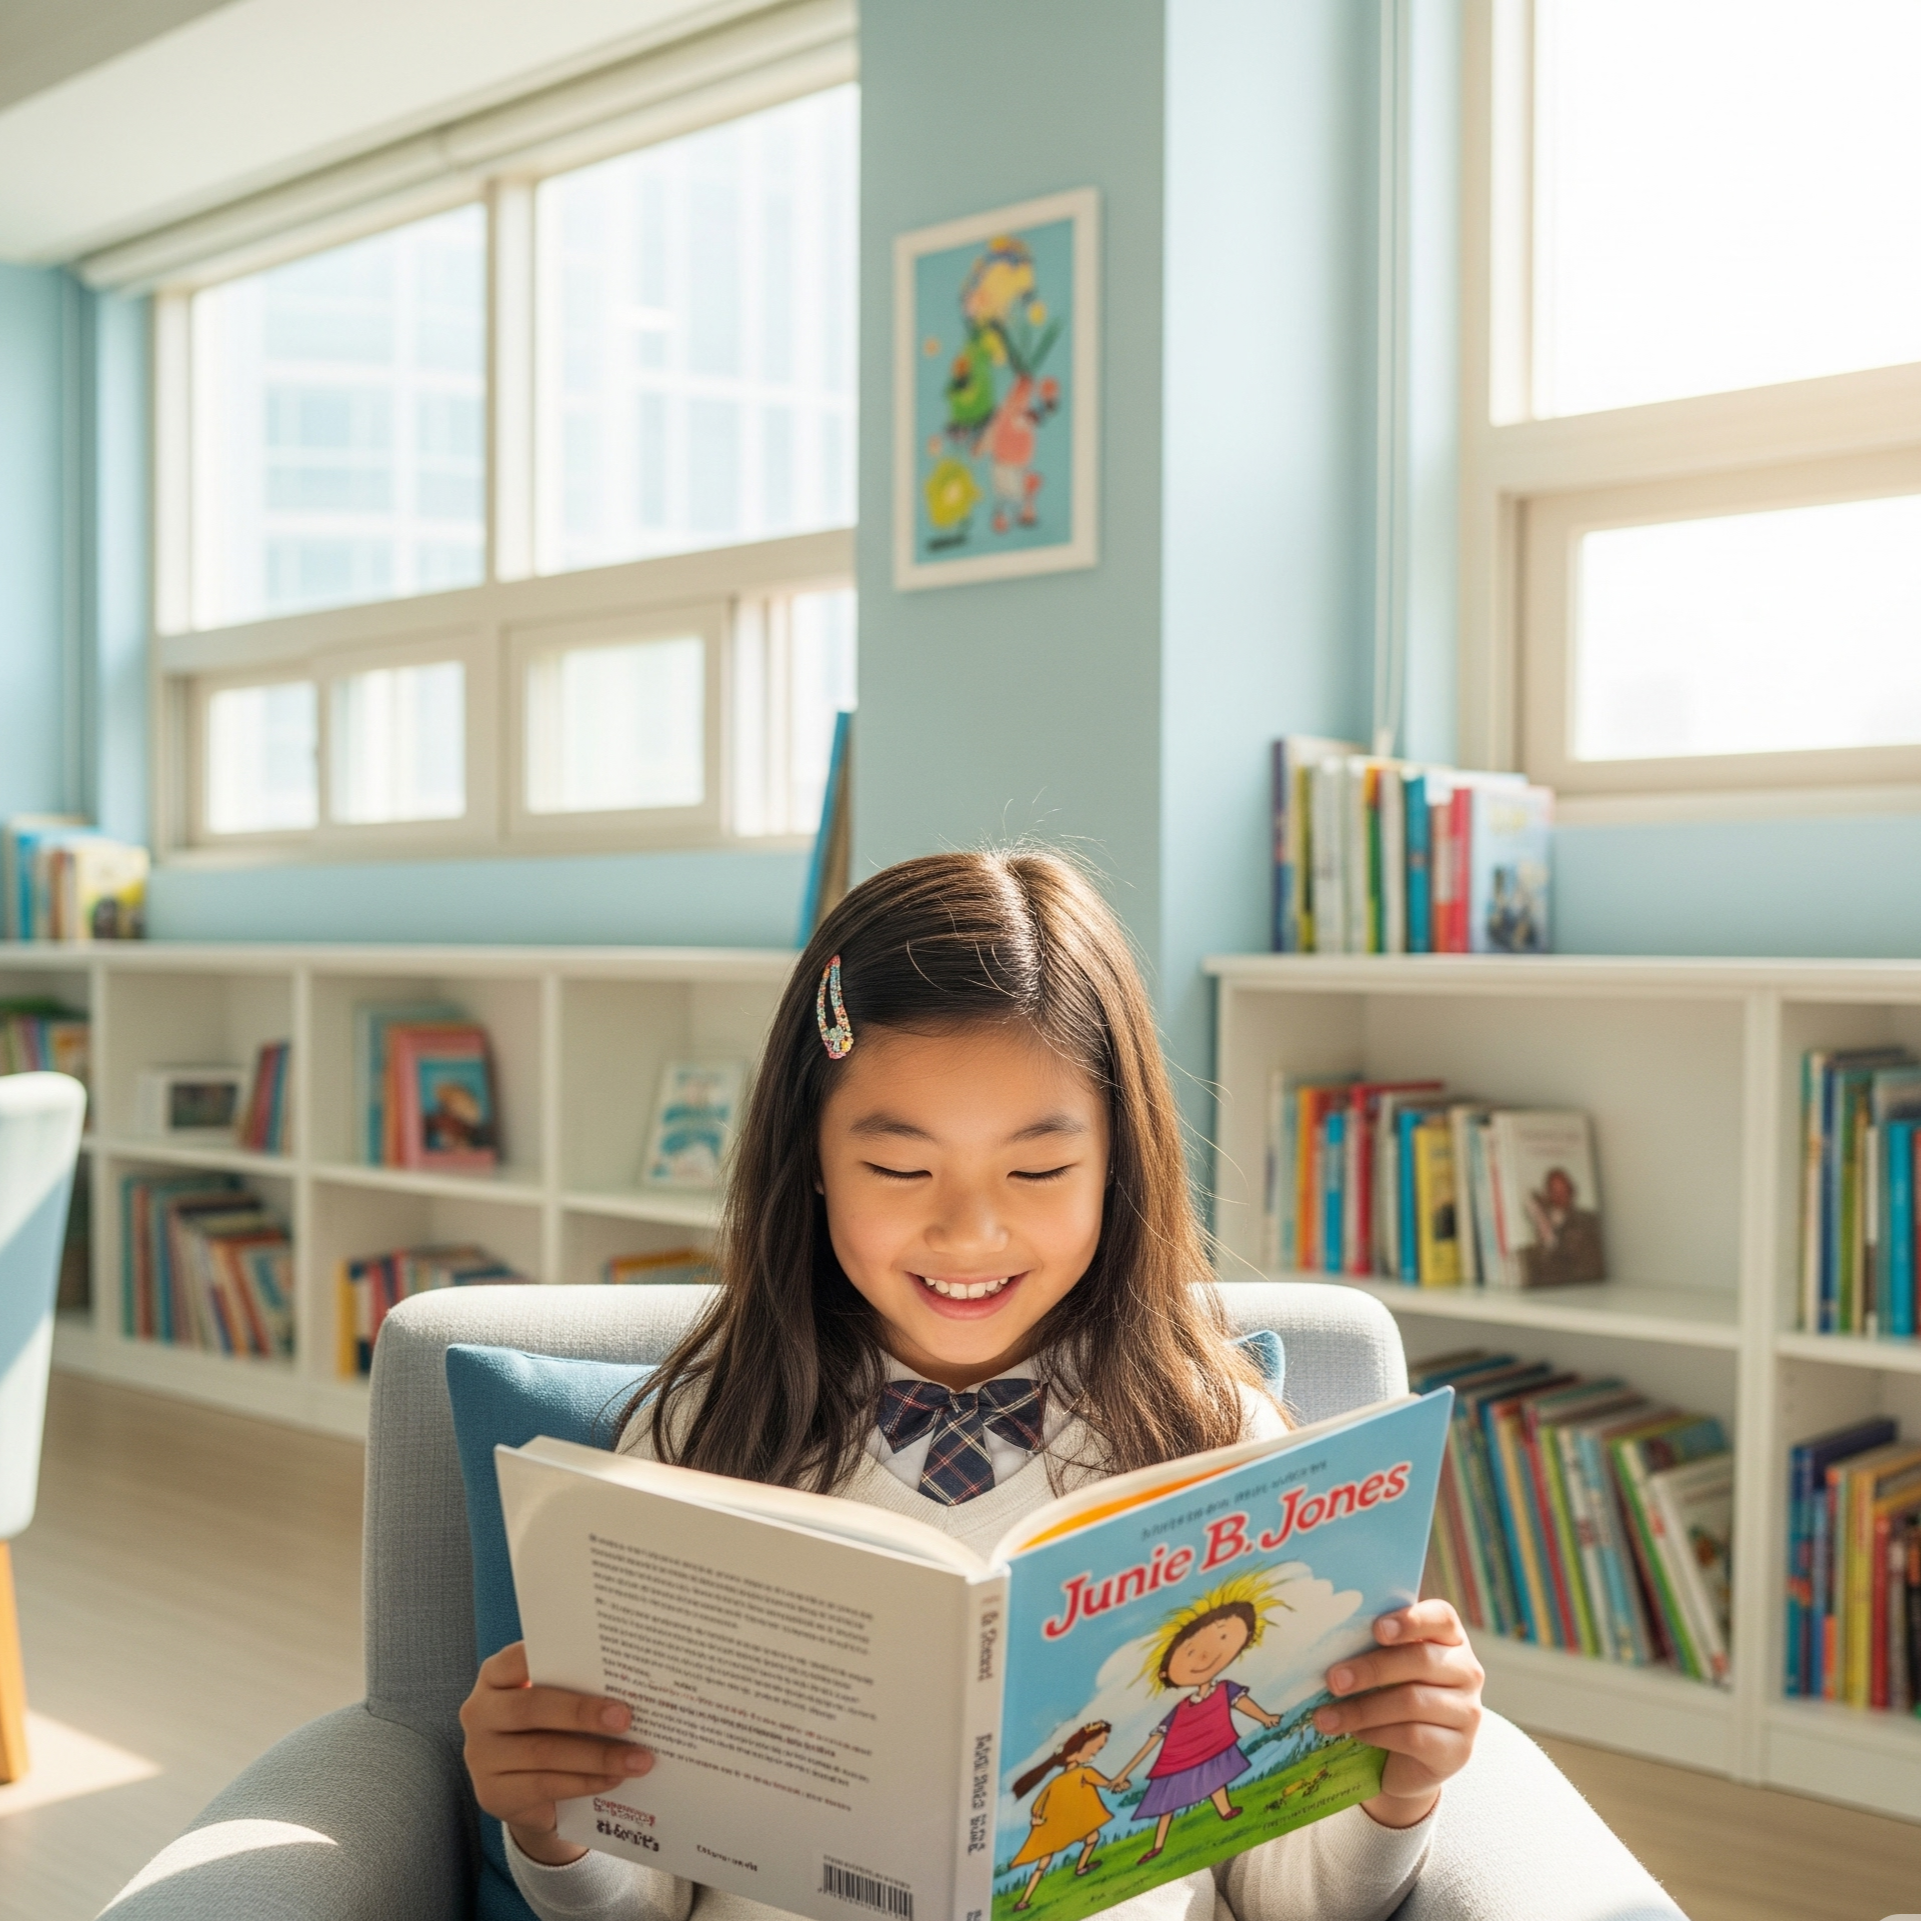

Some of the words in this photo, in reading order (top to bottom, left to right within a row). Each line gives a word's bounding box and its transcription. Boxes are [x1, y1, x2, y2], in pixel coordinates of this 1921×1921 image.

[1043, 1543, 1194, 1639] Junie
[1200, 1512, 1253, 1572] B.
[1260, 1463, 1411, 1549] Jones
